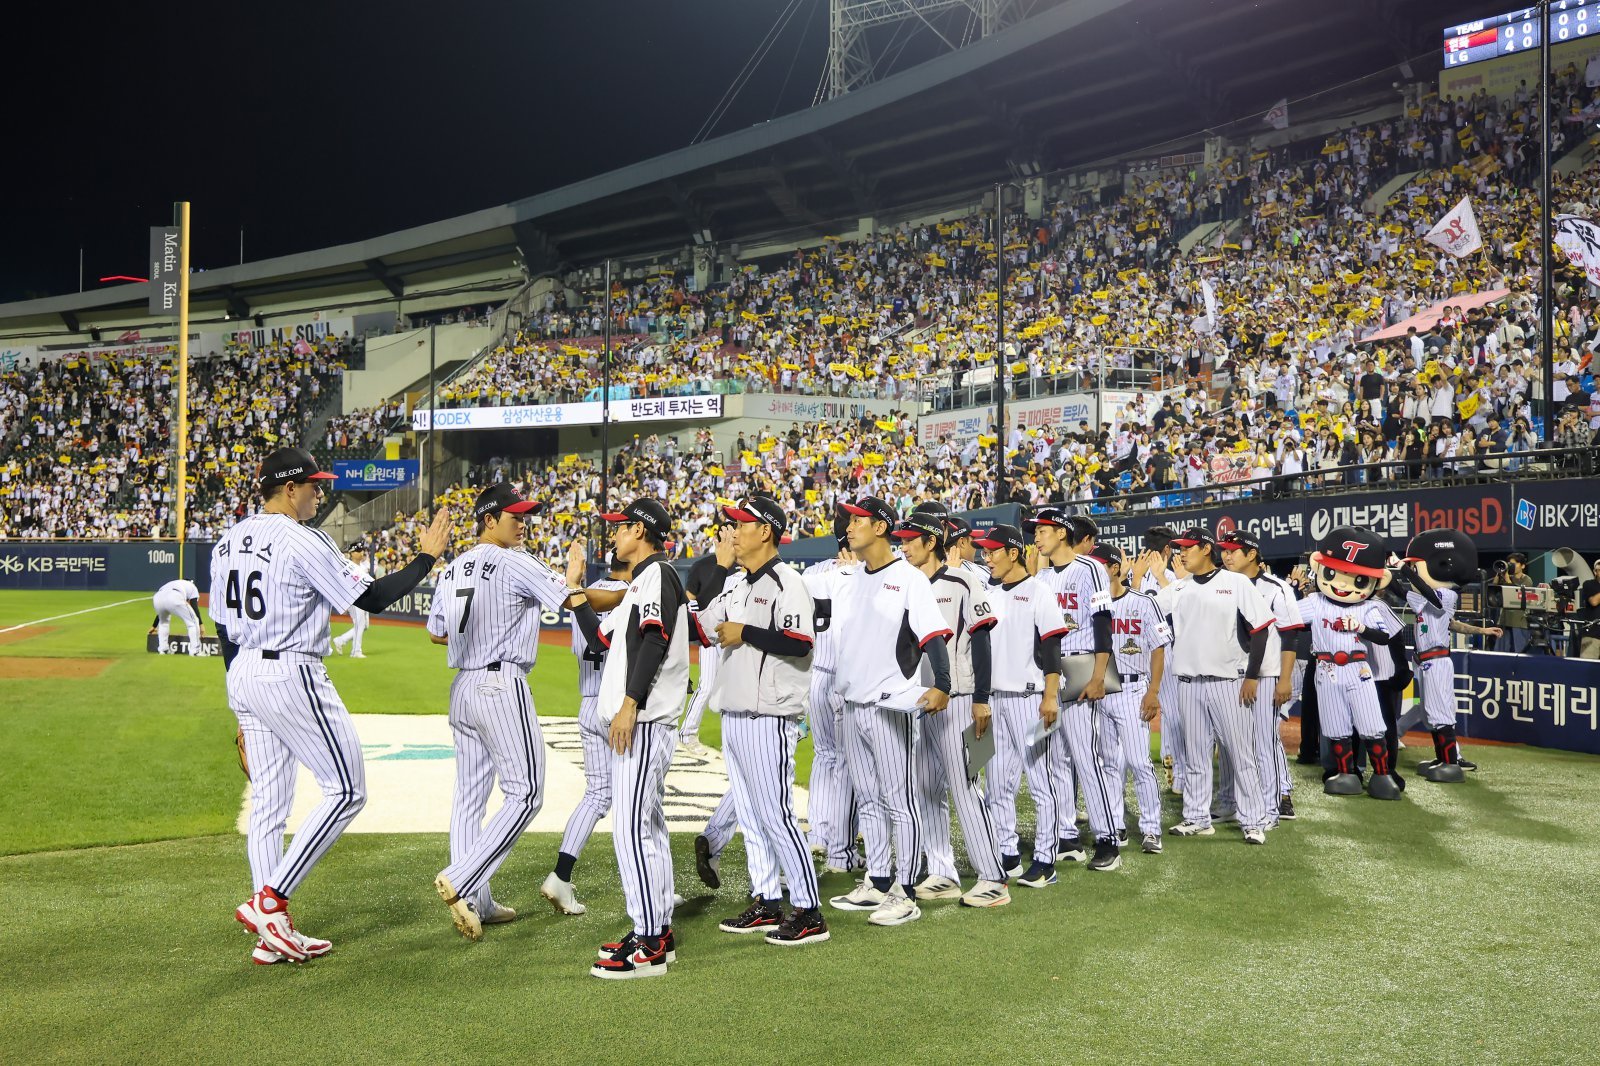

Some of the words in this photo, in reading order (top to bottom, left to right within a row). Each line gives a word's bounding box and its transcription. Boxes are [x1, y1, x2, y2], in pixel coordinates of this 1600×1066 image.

[1456, 22, 1484, 35] TEAM
[1559, 1, 1567, 9] 4
[1505, 27, 1514, 38] 0
[1523, 23, 1532, 33] 0
[1559, 14, 1568, 25] 0
[1577, 10, 1587, 20] 0
[1505, 41, 1514, 51] 4
[1523, 37, 1532, 47] 0
[1559, 28, 1568, 39] 0
[1577, 24, 1587, 34] 0
[164, 233, 177, 272] Matin
[163, 282, 177, 310] Kim
[431, 411, 471, 425] KODEX
[502, 406, 563, 424] 삼성자산운용
[631, 401, 665, 417] 반도체
[667, 398, 704, 416] 투자는
[1027, 406, 1062, 427] 파이팅은
[1062, 403, 1089, 423] 트윈스
[957, 417, 981, 435] 구론산
[275, 467, 304, 479] LGE.COM
[346, 469, 362, 479] NH
[364, 465, 406, 481] 올원더풀
[633, 508, 657, 525] LGE.COM
[763, 511, 783, 530] LGE.COM
[1051, 515, 1075, 532] LGE.COM
[950, 528, 967, 537] LGE.COM
[147, 550, 175, 564] 100m
[219, 535, 272, 564] 리오스
[444, 559, 497, 581] 이영빈
[226, 569, 266, 620] 46
[1065, 583, 1076, 591] LG
[455, 587, 475, 634] 7
[643, 602, 661, 618] 85
[974, 601, 992, 617] 80
[1126, 609, 1139, 617] LG
[783, 614, 801, 629] 81
